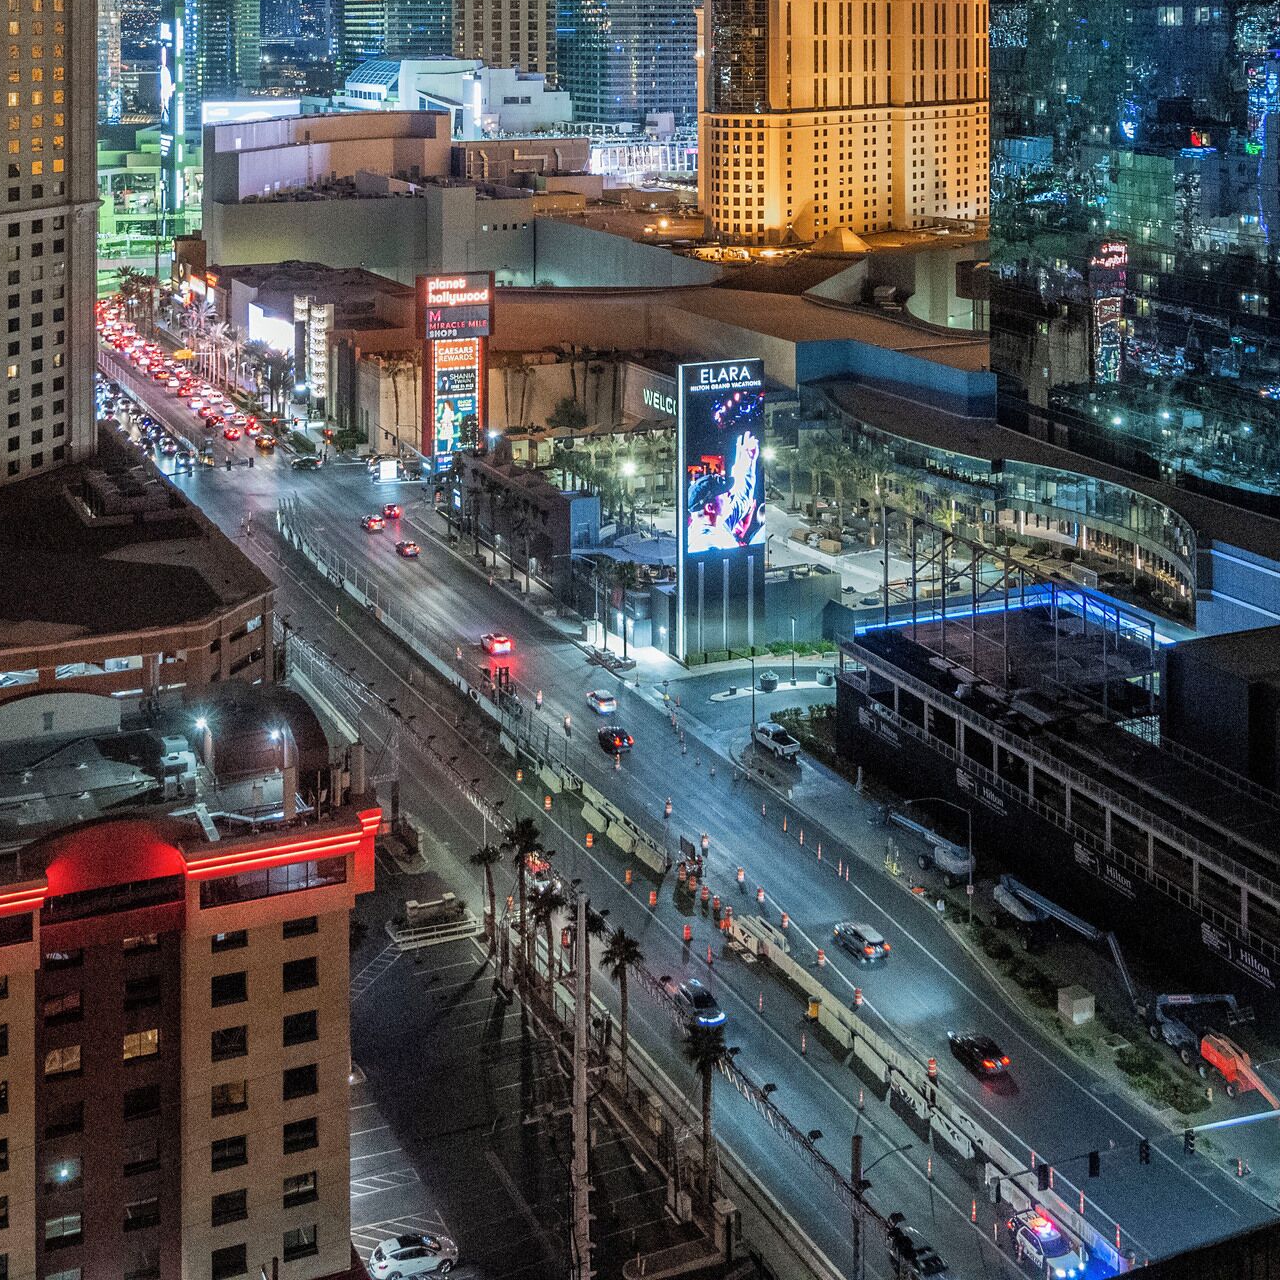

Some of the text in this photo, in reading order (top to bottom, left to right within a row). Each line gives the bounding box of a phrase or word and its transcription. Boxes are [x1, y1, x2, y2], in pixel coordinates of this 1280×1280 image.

[428, 278, 466, 293] planet
[428, 289, 489, 306] hollywood
[429, 319, 487, 330] MIRACLE MILE
[429, 329, 457, 338] SHOPS
[438, 346, 473, 355] CAESARS
[449, 373, 475, 381] SHANIA
[700, 366, 751, 384] ELARA
[690, 380, 762, 392] HILTON GRAND VACATIONS
[643, 388, 676, 416] WELC
[1240, 948, 1270, 978] Hilton
